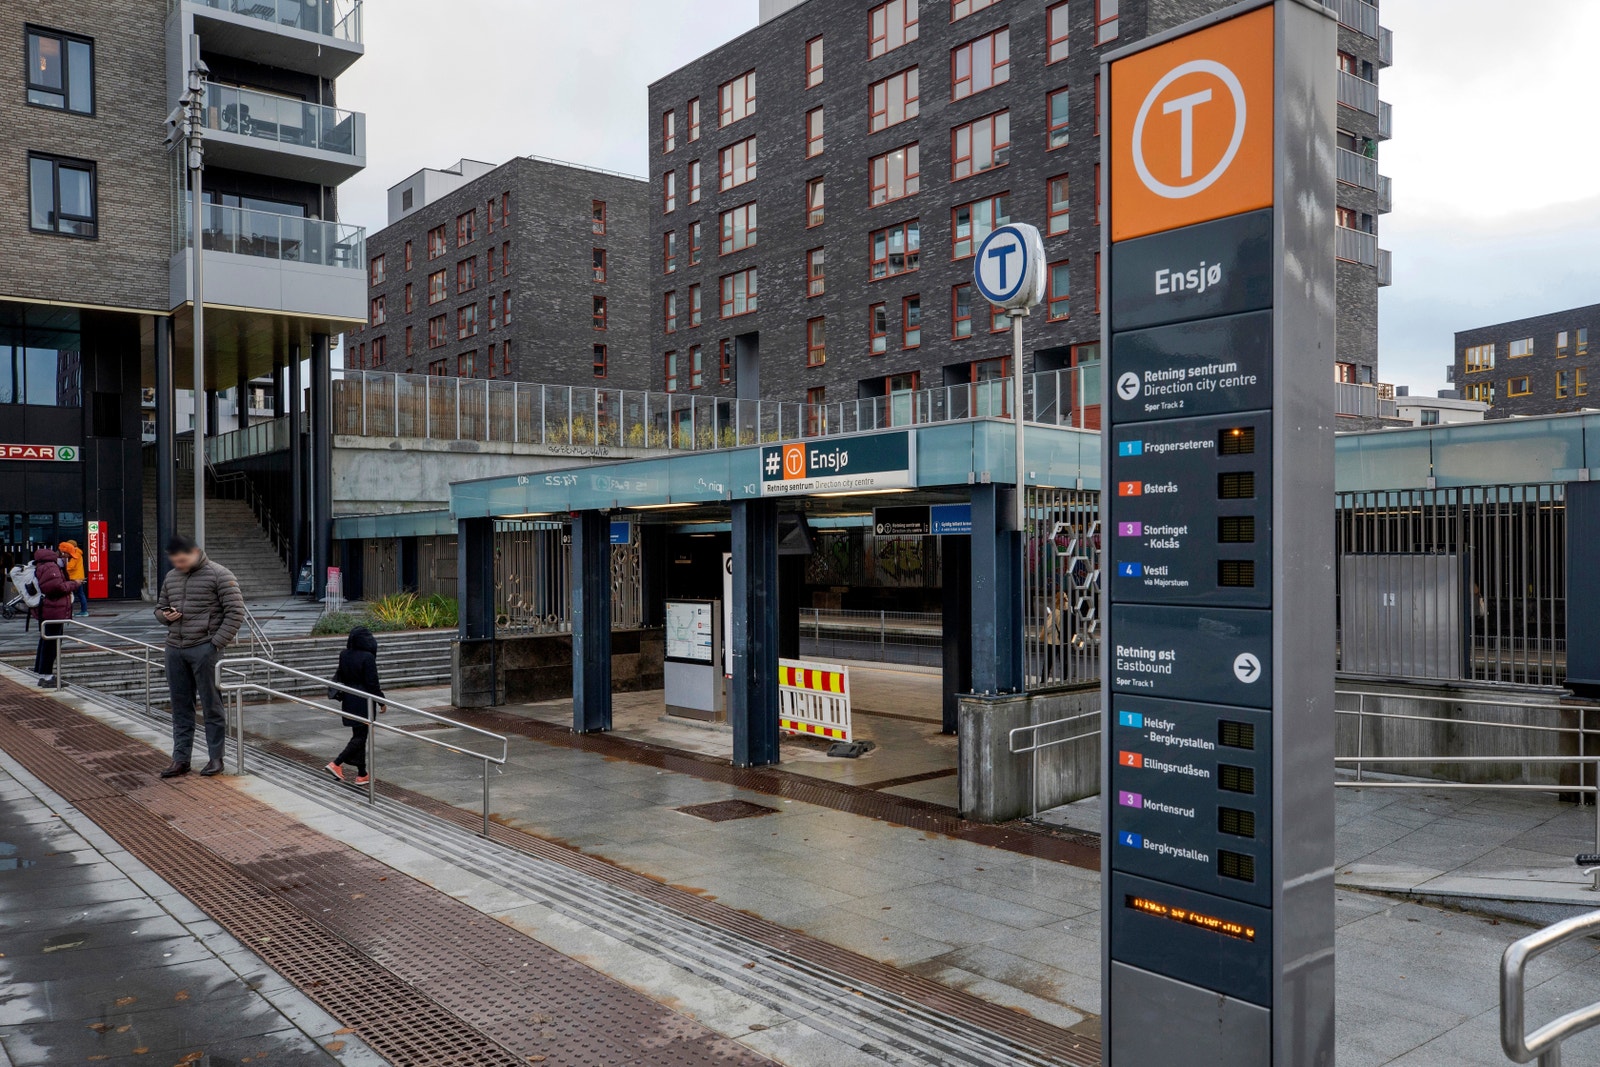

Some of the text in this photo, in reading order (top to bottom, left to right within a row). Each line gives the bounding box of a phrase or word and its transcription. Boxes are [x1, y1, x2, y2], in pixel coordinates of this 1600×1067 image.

[1162, 88, 1212, 179] T
[988, 243, 1016, 290] T
[1155, 261, 1222, 295] Ensjø
[1144, 362, 1237, 382] Retning sentrum
[1144, 374, 1257, 396] Direction city centre
[1144, 400, 1184, 412] Spor Track 2
[0, 446, 54, 458] SPAR
[1144, 439, 1214, 454] Frognerseteren
[810, 447, 848, 472] Ensjø
[767, 478, 874, 493] Retning sentrum Direction city centre
[1144, 481, 1178, 494] Østerås
[1143, 525, 1188, 537] Stortinget
[90, 533, 98, 562] SPAR
[1150, 537, 1180, 549] Kolsås
[1143, 565, 1168, 576] Vestli
[1144, 578, 1189, 588] via Majorstuen
[1116, 645, 1176, 661] Retning øst
[1116, 659, 1172, 674] Eastbound
[1116, 677, 1131, 686] Spor
[1132, 678, 1149, 687] Track
[1144, 717, 1176, 731] Helsfyr
[1150, 731, 1215, 750] Bergkrystallen
[1143, 757, 1210, 778] Ellingsrudåsen
[1143, 798, 1194, 818] Mortensrud
[1143, 838, 1209, 863] Bergkrystallen
